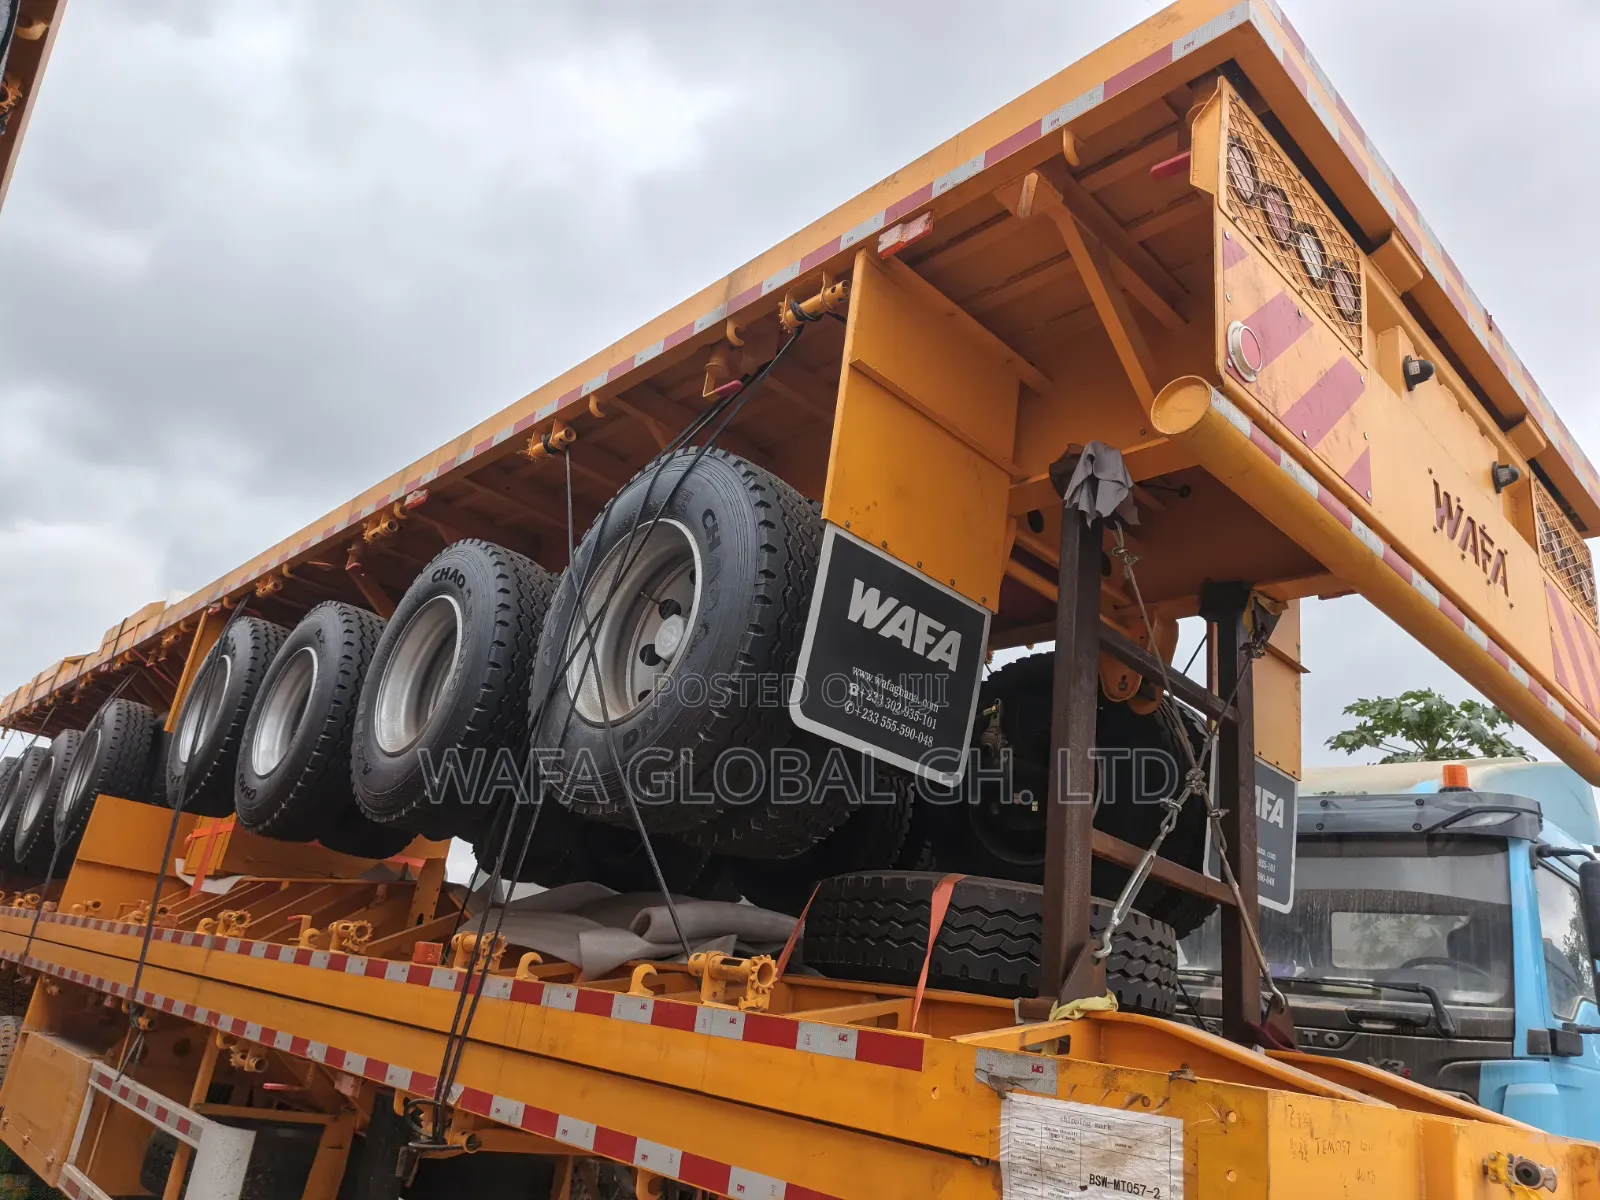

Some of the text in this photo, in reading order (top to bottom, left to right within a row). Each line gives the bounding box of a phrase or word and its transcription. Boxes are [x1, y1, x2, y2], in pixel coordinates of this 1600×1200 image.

[1432, 478, 1509, 598] WAFA
[431, 566, 466, 589] CHAO
[847, 577, 962, 672] WAFA
[855, 706, 934, 748] +233 555-590-048
[884, 696, 936, 728] 302-935-101
[1255, 785, 1285, 829] FA
[1059, 1115, 1112, 1131] shipping mark
[1089, 1173, 1161, 1199] BSW-MT057-2
